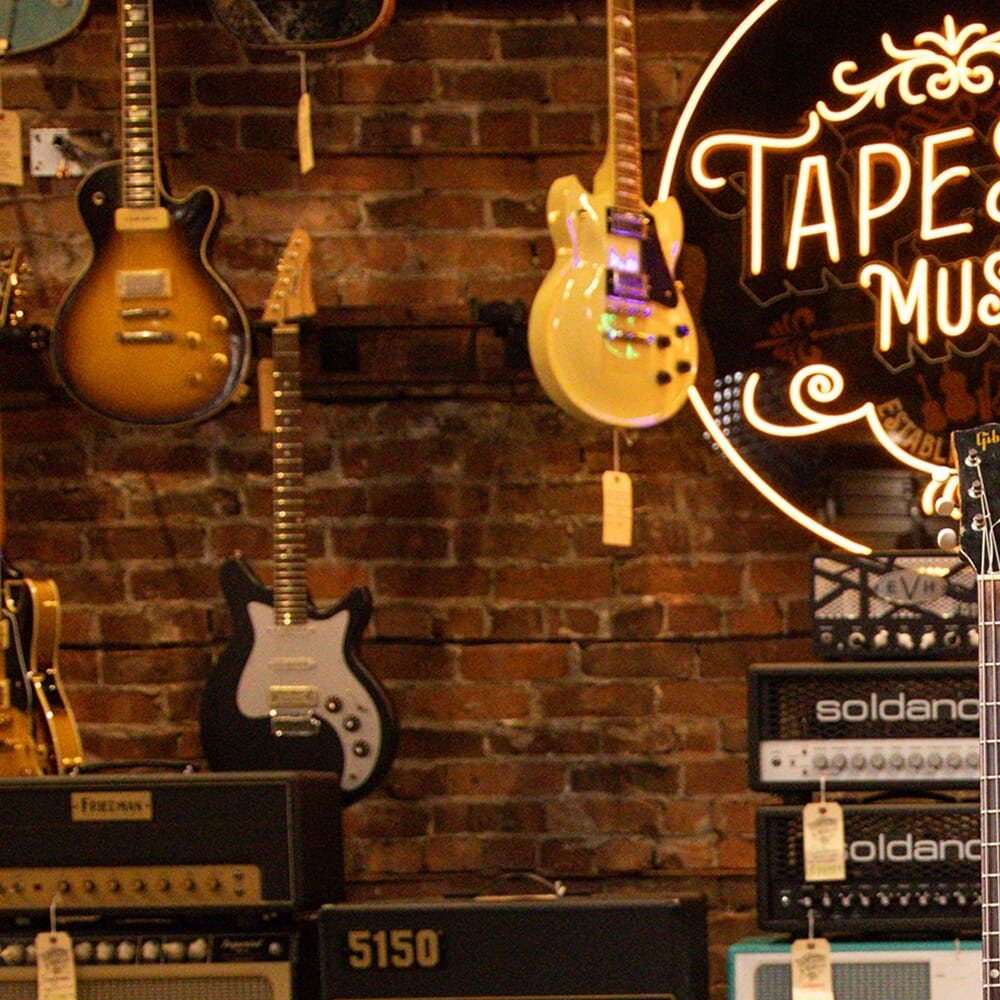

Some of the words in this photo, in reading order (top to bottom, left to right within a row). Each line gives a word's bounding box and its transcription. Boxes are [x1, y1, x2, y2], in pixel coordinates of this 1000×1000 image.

[877, 398, 957, 464] ESTABL
[886, 575, 935, 600] EVH
[815, 692, 979, 722] soldano
[845, 832, 980, 862] oldano
[347, 929, 440, 969] 5150
